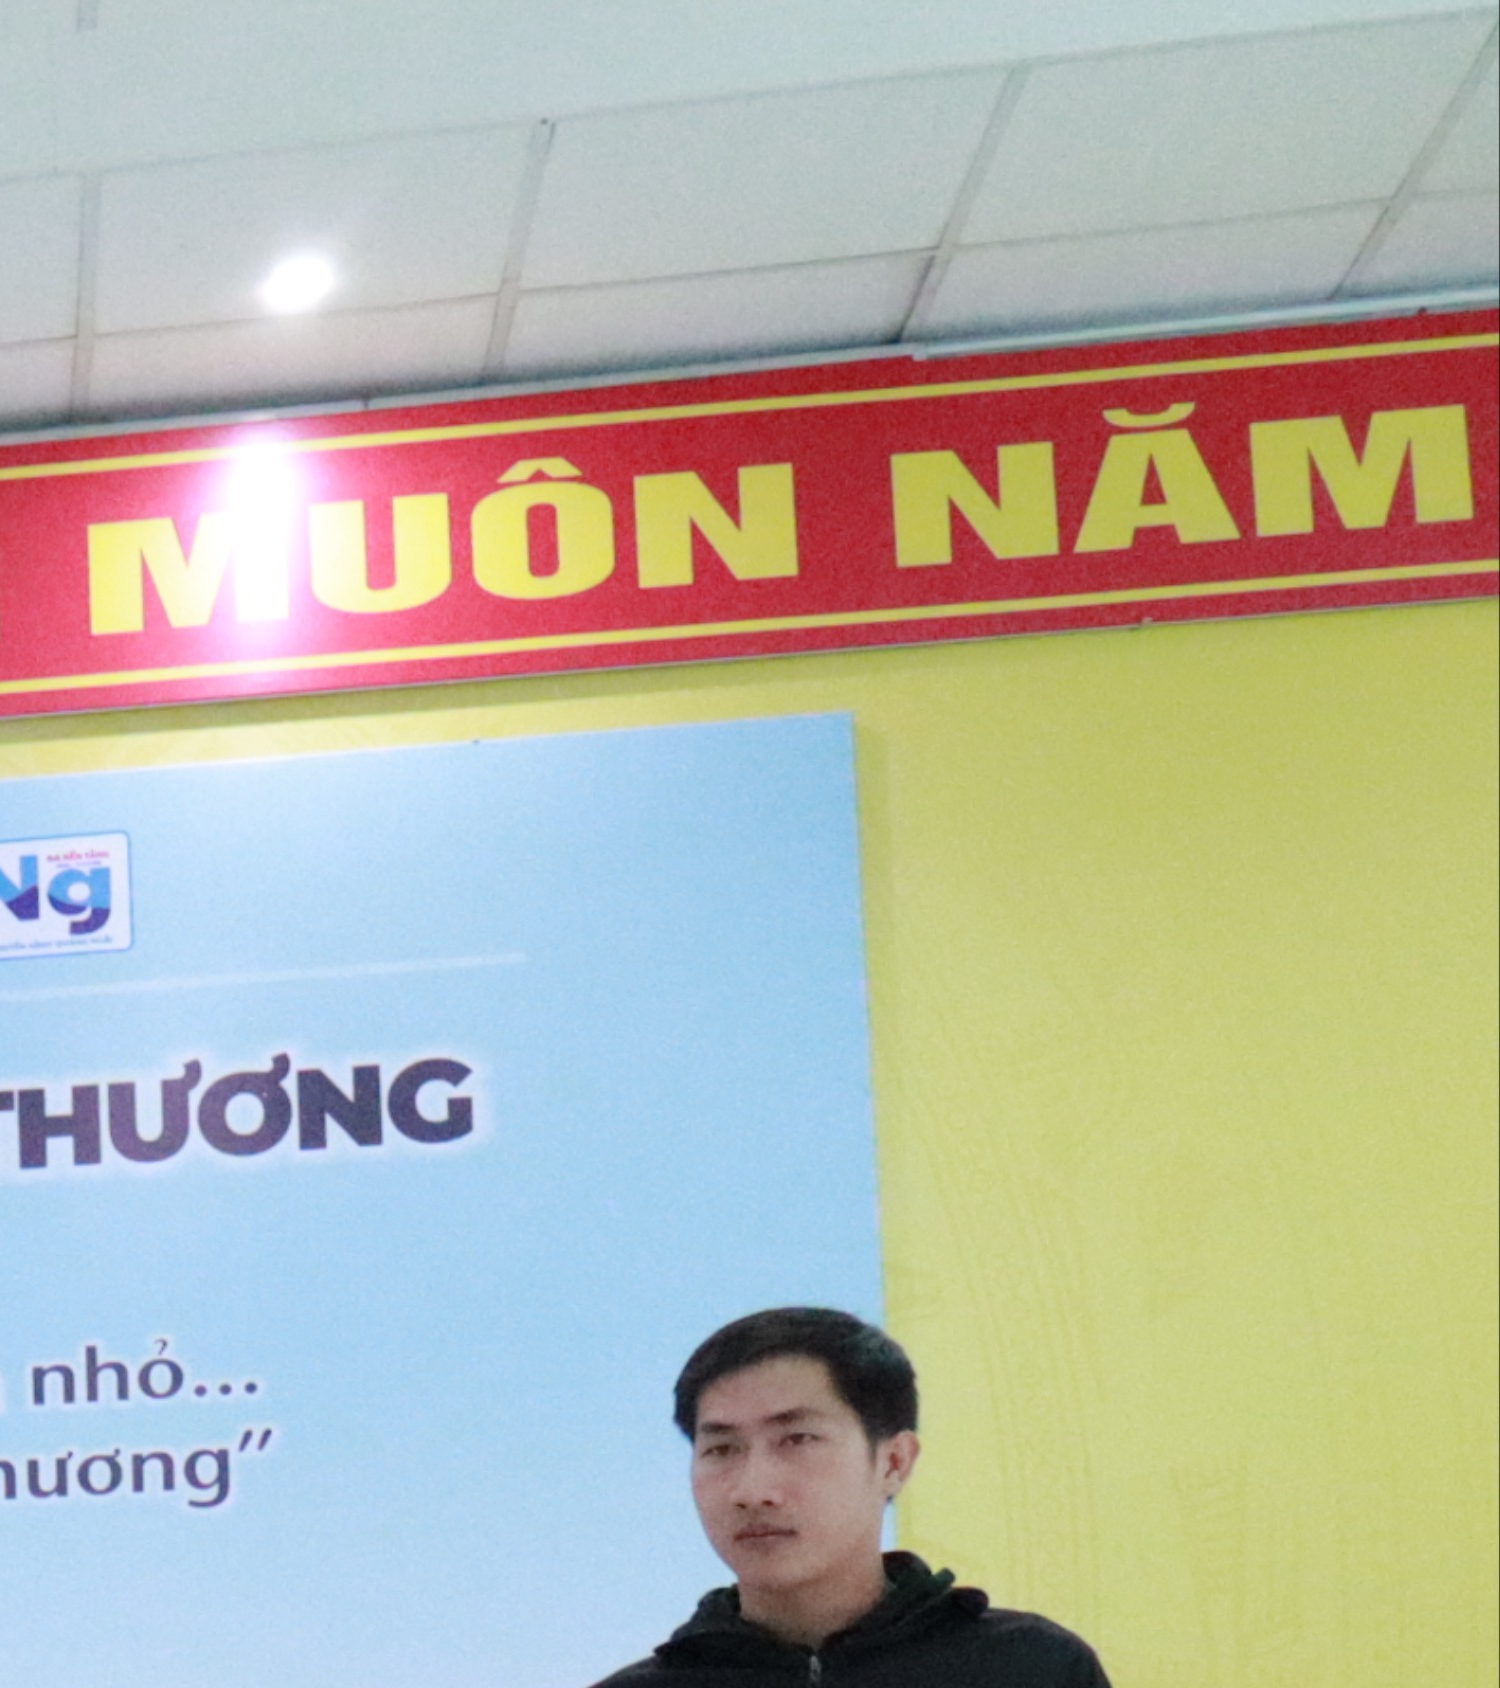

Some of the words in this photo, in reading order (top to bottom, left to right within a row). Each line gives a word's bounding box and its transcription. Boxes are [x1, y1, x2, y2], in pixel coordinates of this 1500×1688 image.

[86, 456, 800, 637] MUÔN
[890, 402, 1474, 569] NĂM
[30, 1339, 261, 1408] nhỏ...
